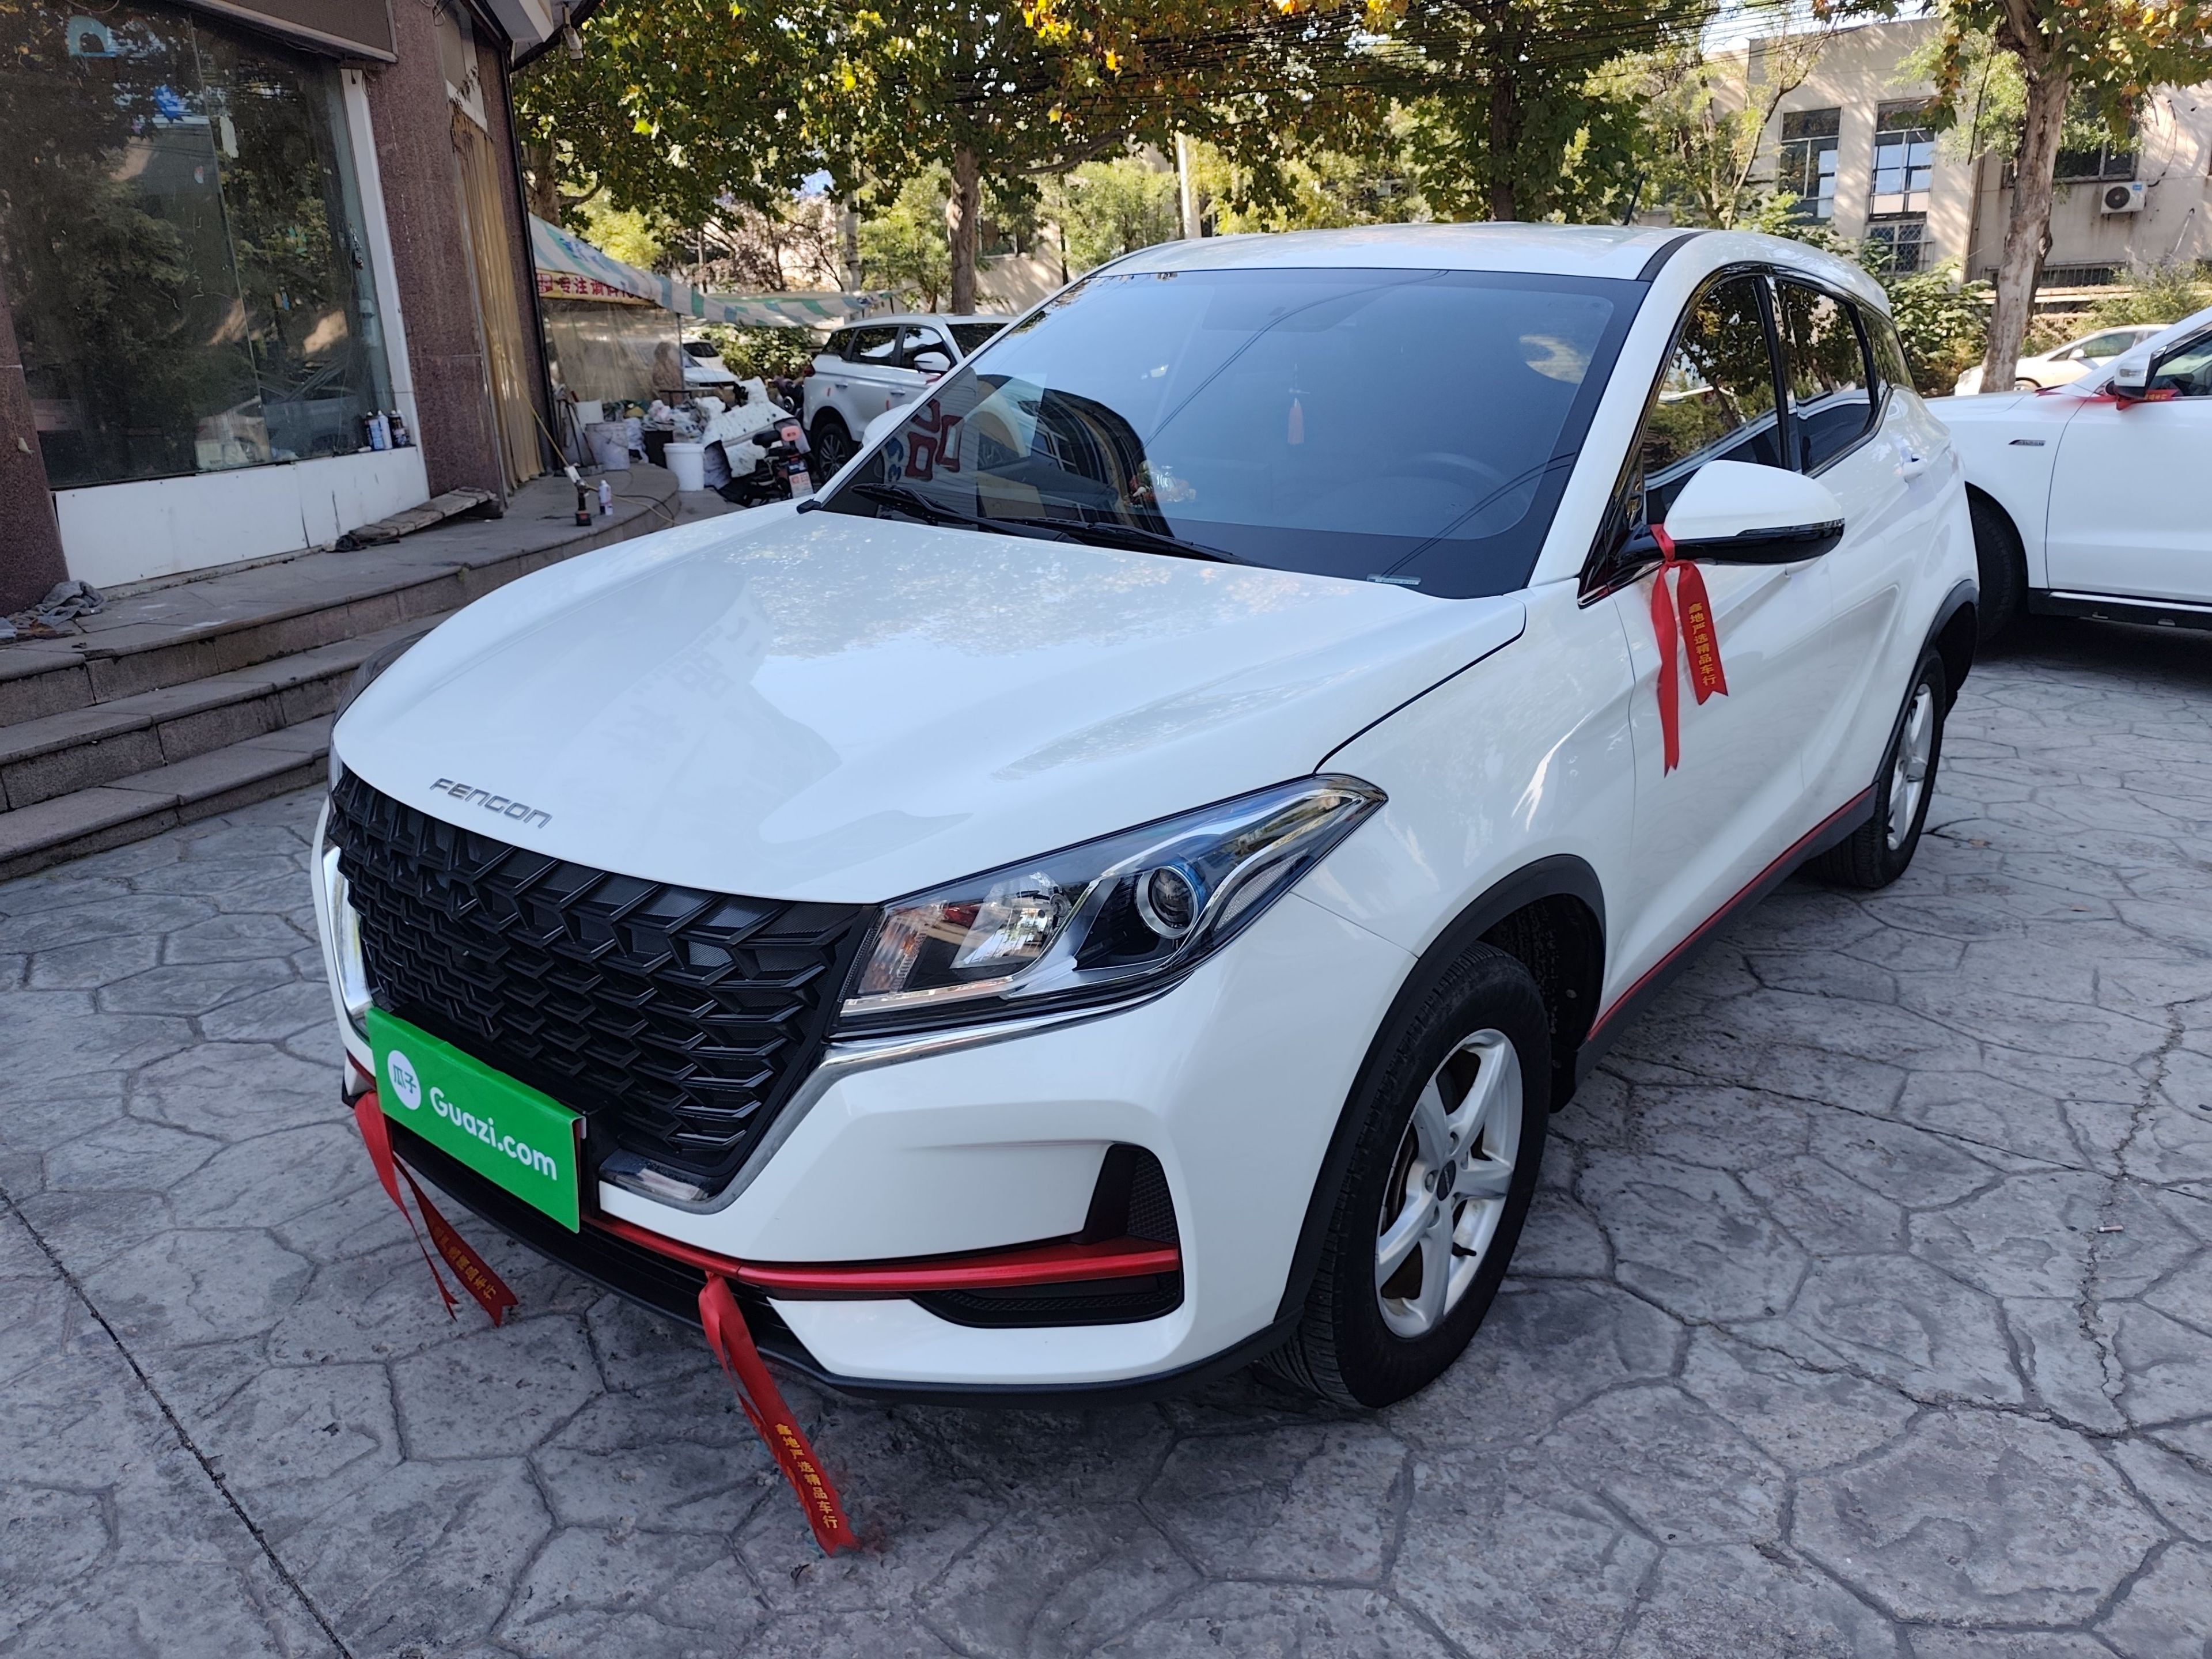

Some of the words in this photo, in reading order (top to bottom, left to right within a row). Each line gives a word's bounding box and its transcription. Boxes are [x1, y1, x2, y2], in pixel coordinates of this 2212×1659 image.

[429, 778, 552, 829] FENGON
[393, 1063, 417, 1094] 瓜子
[429, 1086, 558, 1181] Guazi.com
